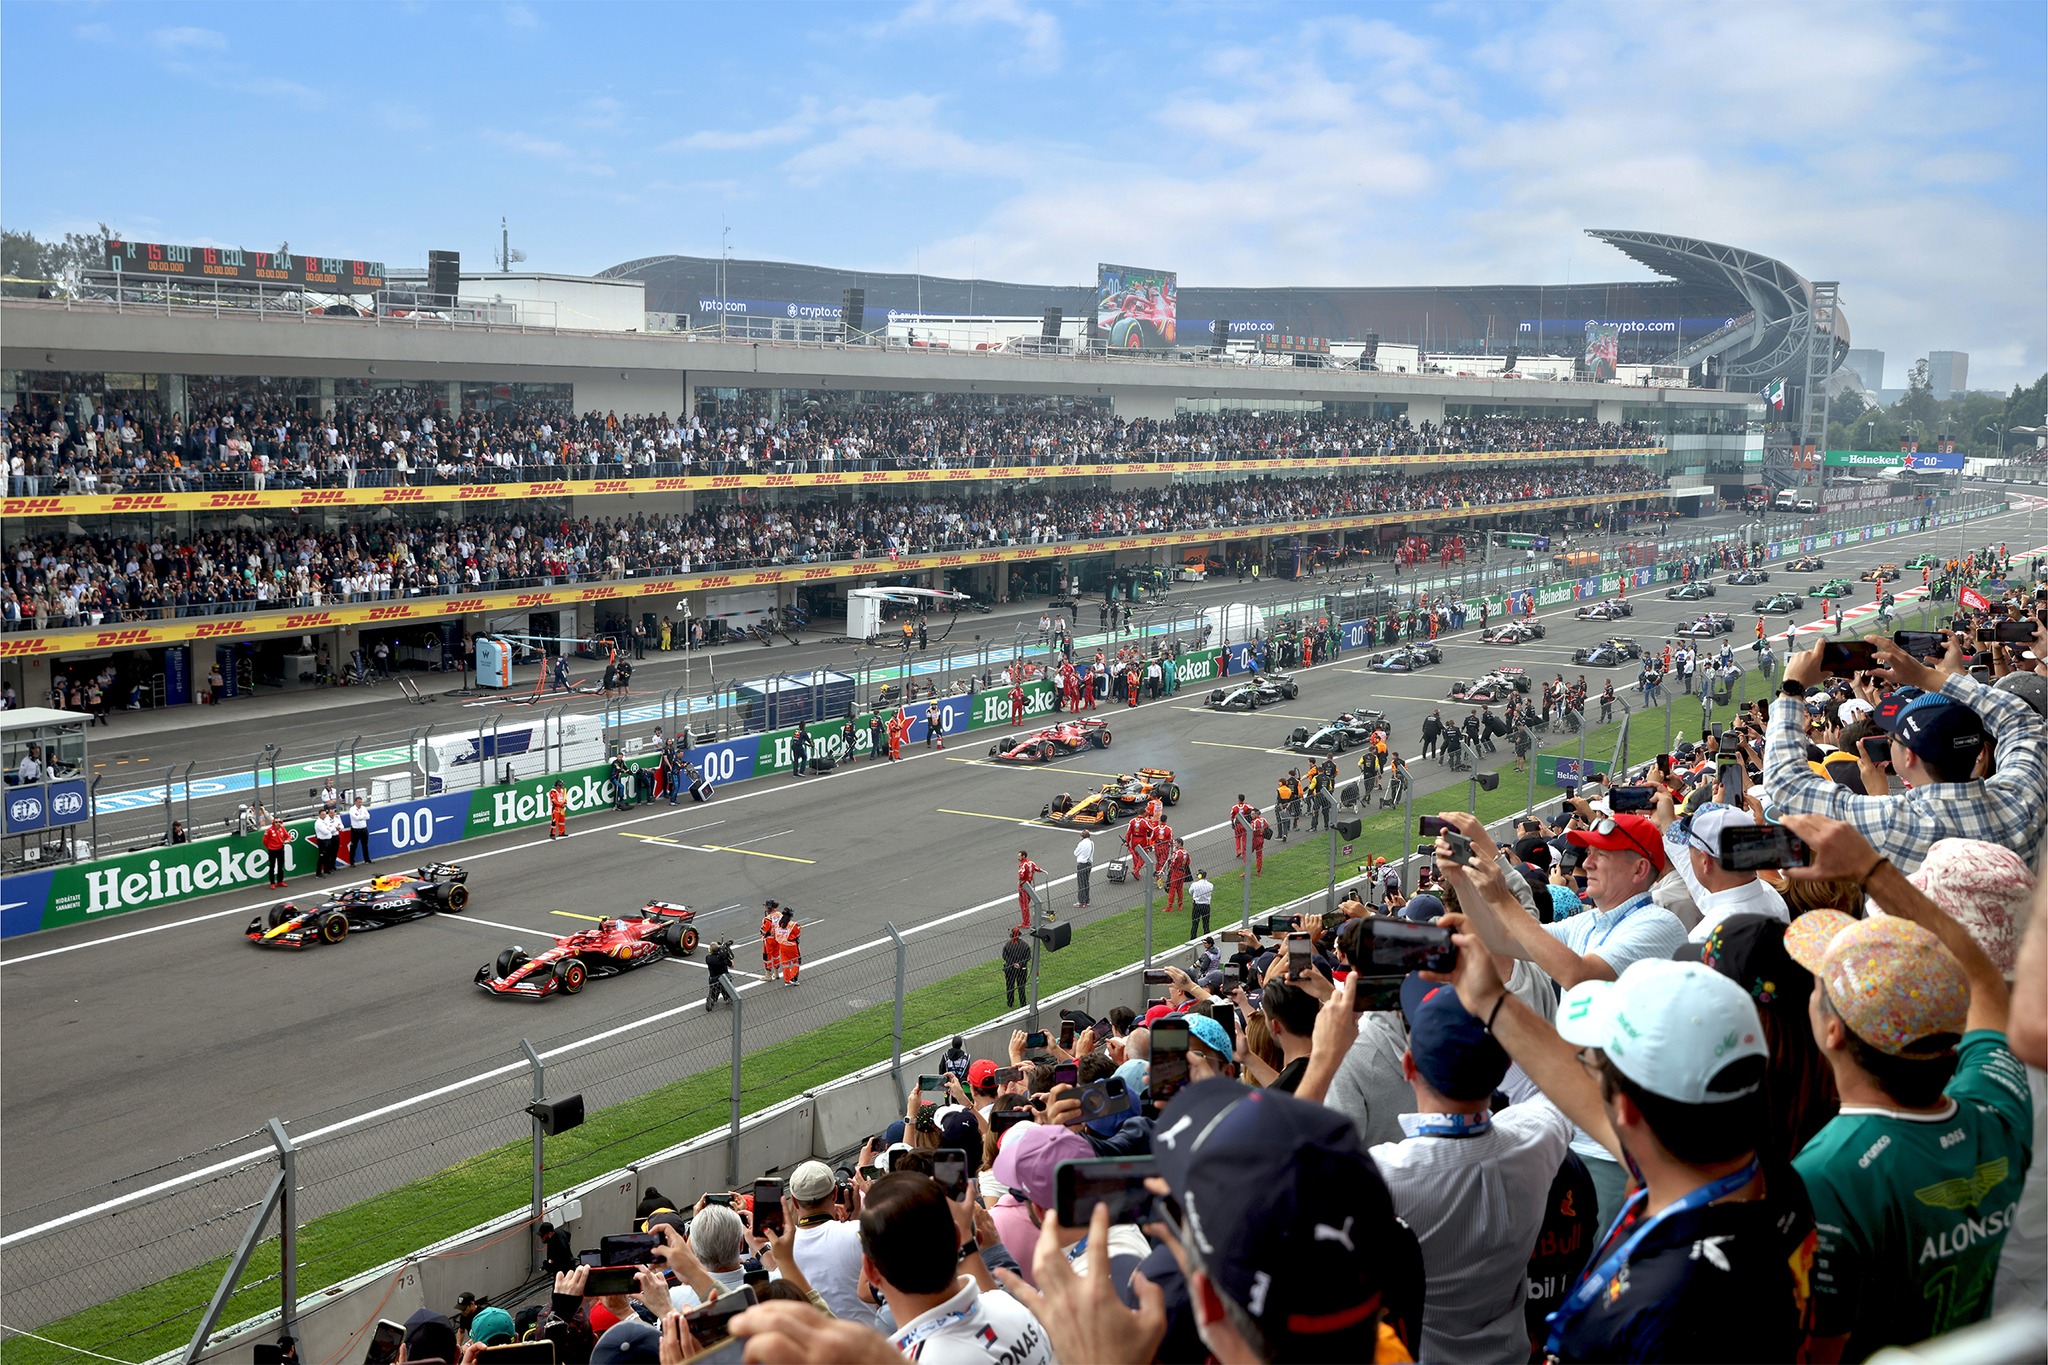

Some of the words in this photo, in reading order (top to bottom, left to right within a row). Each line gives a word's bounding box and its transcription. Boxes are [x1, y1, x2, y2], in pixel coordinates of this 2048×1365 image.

[127, 242, 136, 258] R
[148, 244, 161, 260] 15
[167, 245, 193, 262] BOT
[204, 248, 216, 264] 16
[222, 249, 246, 266] COL
[256, 252, 267, 268] 17
[273, 254, 292, 270] PIA
[306, 256, 317, 272] 18
[322, 258, 344, 274] PER
[353, 260, 364, 276] 19
[1229, 321, 1274, 333] rypto.co
[1804, 451, 1812, 462] A
[1849, 455, 1898, 465] Heineken
[3, 499, 64, 514] DHL
[112, 496, 167, 510] DHL
[210, 493, 262, 506] DHL
[301, 491, 346, 504] DHL
[382, 489, 425, 501] DHL
[458, 486, 498, 498] DHL
[530, 484, 566, 495] DHL
[595, 482, 628, 493] DHL
[656, 480, 686, 490] DHL
[712, 476, 742, 487] DHL
[766, 475, 794, 486] DHL
[815, 474, 842, 484] DHL
[863, 472, 888, 482] DHL
[907, 472, 931, 480] DHL
[950, 470, 972, 478] DHL
[989, 469, 1010, 477] DHL
[1026, 468, 1047, 476] DHL
[1096, 466, 1114, 474] DHL
[97, 630, 152, 646] DHL
[195, 621, 247, 636] DHL
[286, 613, 334, 628] DHL
[369, 605, 413, 620] DHL
[445, 599, 486, 612] DHL
[516, 594, 553, 606] DHL
[583, 588, 617, 600] DHL
[644, 582, 677, 594] DHL
[701, 576, 731, 588] DHL
[755, 572, 784, 582] DHL
[805, 568, 832, 578] DHL
[853, 564, 878, 574] DHL
[898, 560, 922, 569] DHL
[940, 556, 962, 565] DHL
[980, 553, 1001, 562] DHL
[1018, 550, 1038, 558] DHL
[1054, 546, 1072, 554] DHL
[1088, 543, 1105, 551] DHL
[1120, 540, 1137, 548] DHL
[1540, 588, 1571, 606] Heineken
[1352, 626, 1364, 646] 0.0
[704, 748, 735, 783] 0.0
[13, 801, 39, 819] FIA
[55, 795, 80, 812] FIA
[391, 807, 434, 848] 0.0
[55, 894, 80, 904] HIDRÁTATE
[55, 902, 80, 912] SANAMENTE
[372, 898, 412, 911] ORACLE
[800, 1108, 809, 1119] 71
[1940, 1128, 1966, 1150] BOSS
[1858, 1134, 1892, 1169] aramco
[620, 1182, 632, 1195] 72
[1541, 1223, 1581, 1257] Bull
[1918, 1202, 2018, 1265] ALONSO
[398, 1274, 414, 1290] 73
[1527, 1277, 1556, 1300] bil
